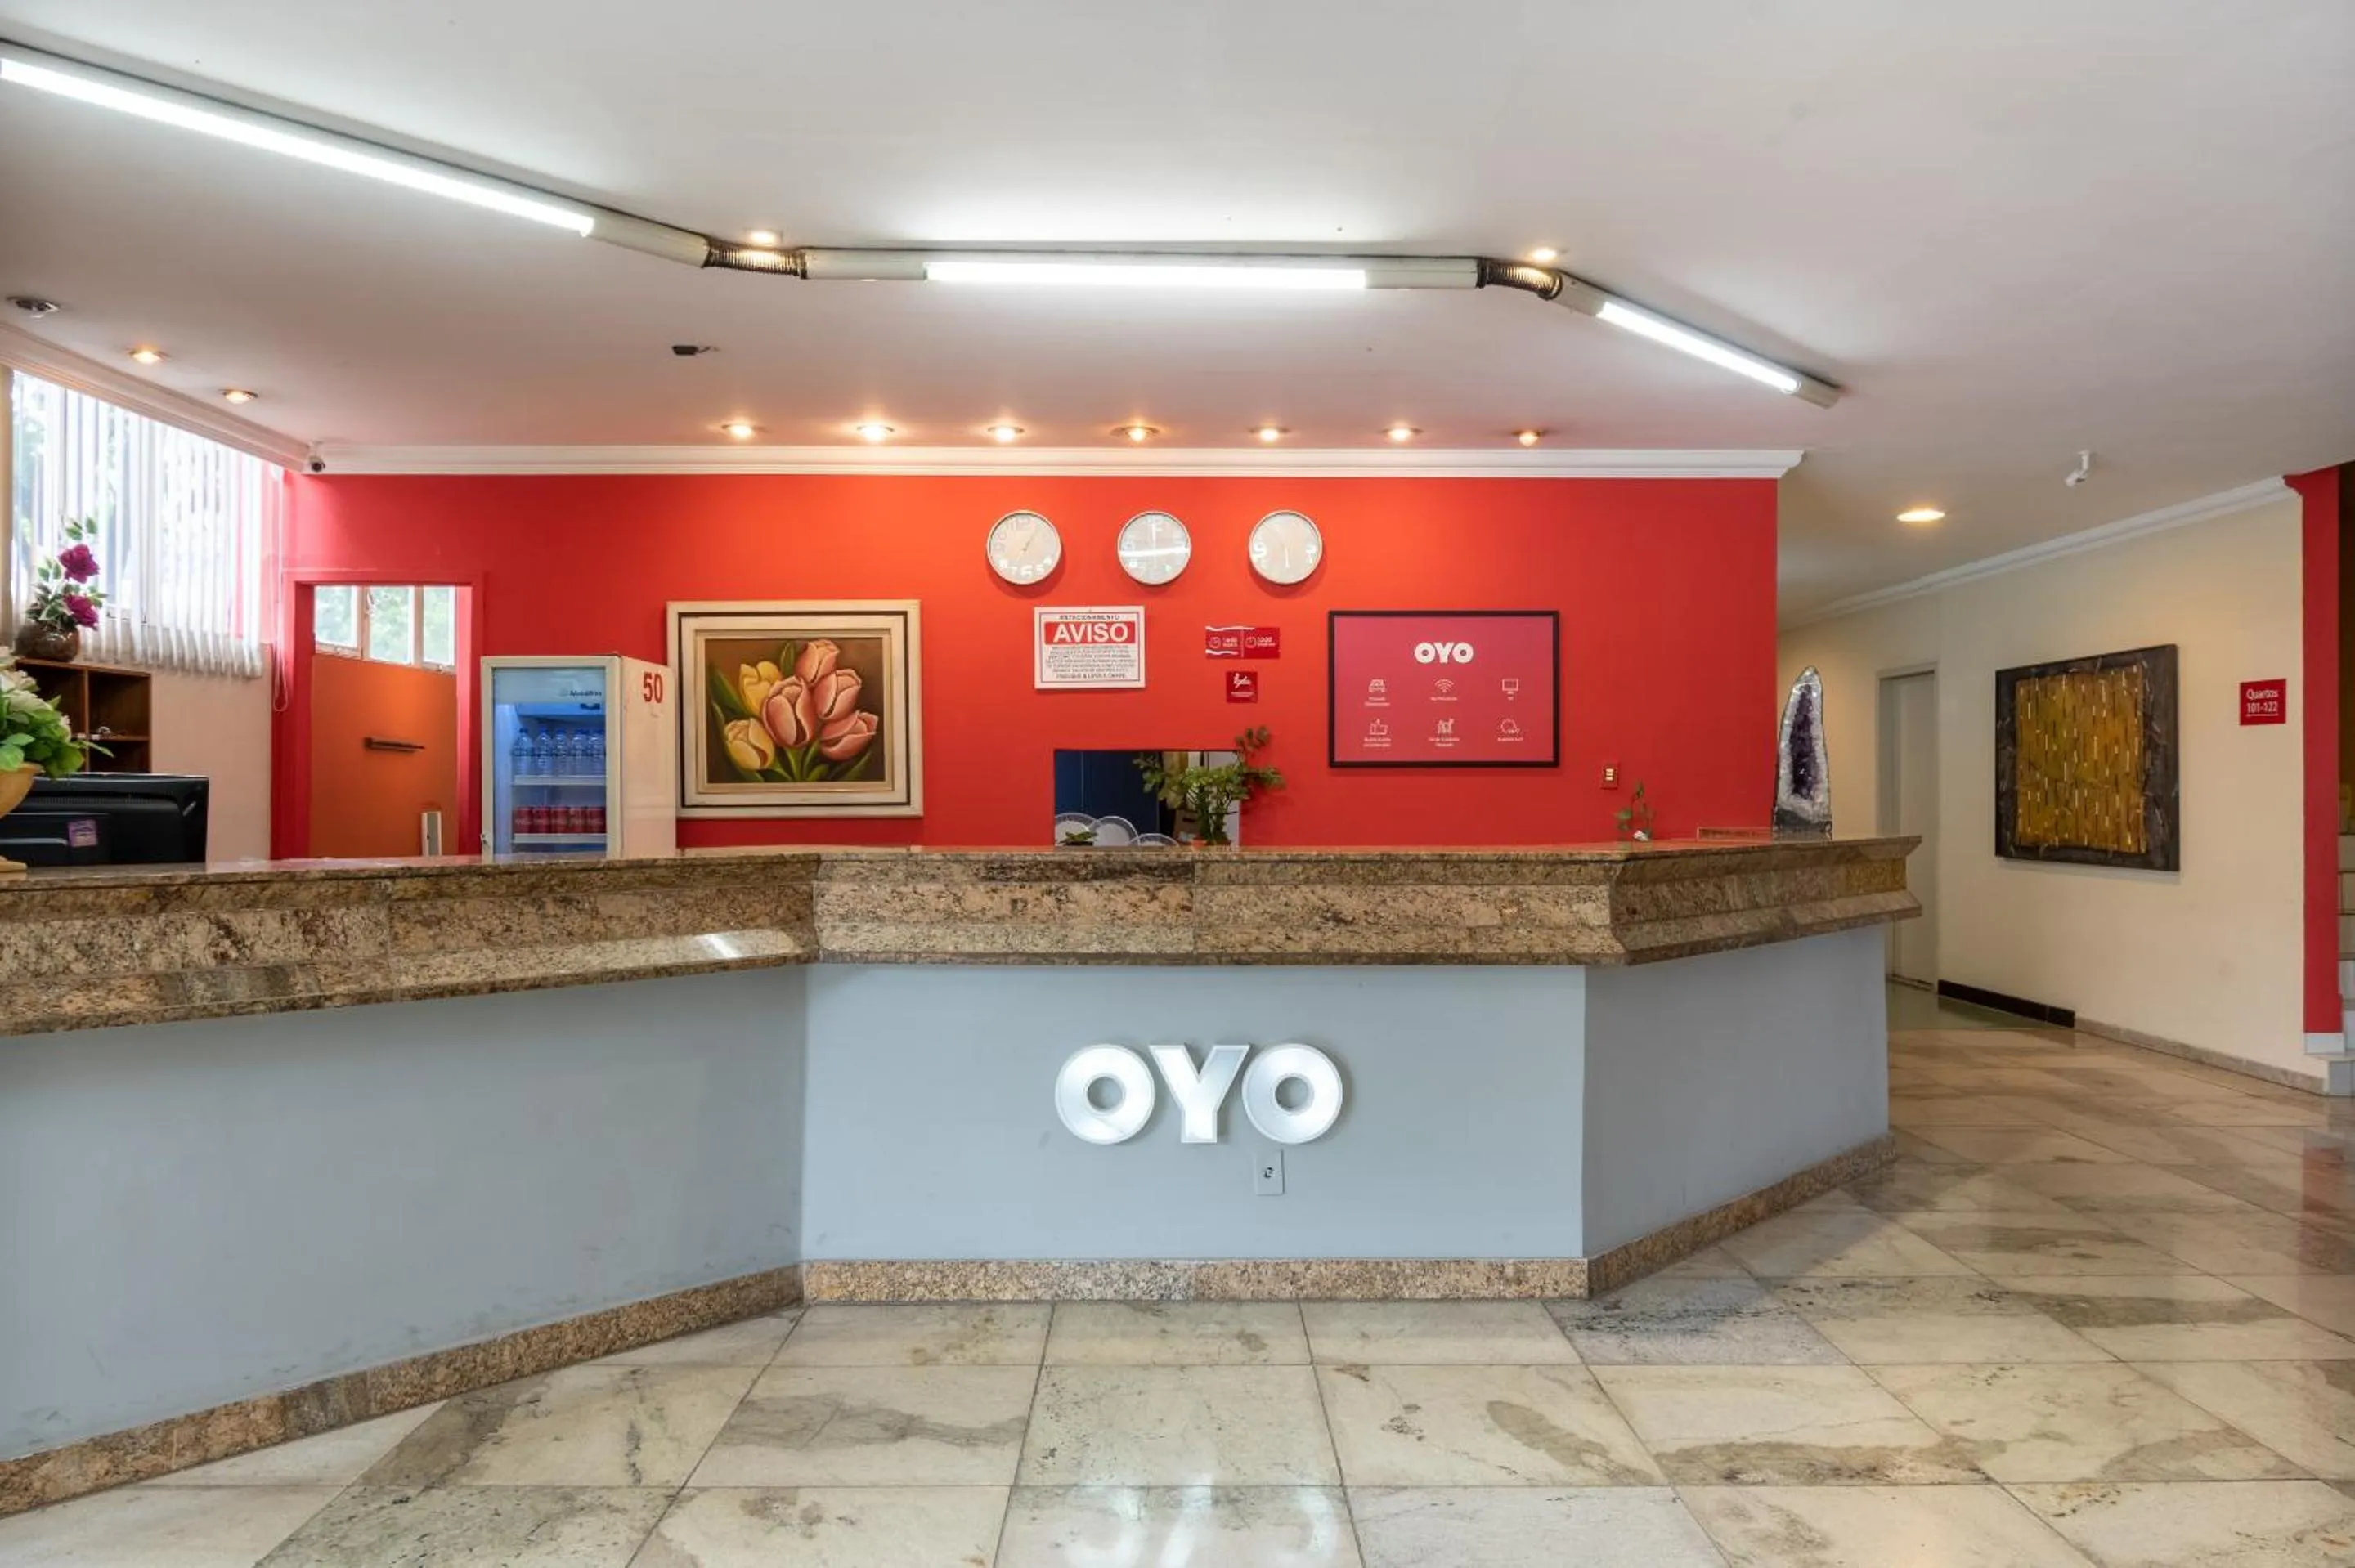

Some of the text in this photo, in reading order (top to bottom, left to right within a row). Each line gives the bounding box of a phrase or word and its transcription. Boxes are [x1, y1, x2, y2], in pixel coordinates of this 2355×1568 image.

[1053, 623, 1128, 643] AVISO
[1415, 642, 1474, 664] OYO
[644, 671, 663, 704] 50
[2246, 688, 2279, 700] Quartos
[2247, 701, 2277, 713] 101-122
[1055, 1043, 1343, 1145] OYO
